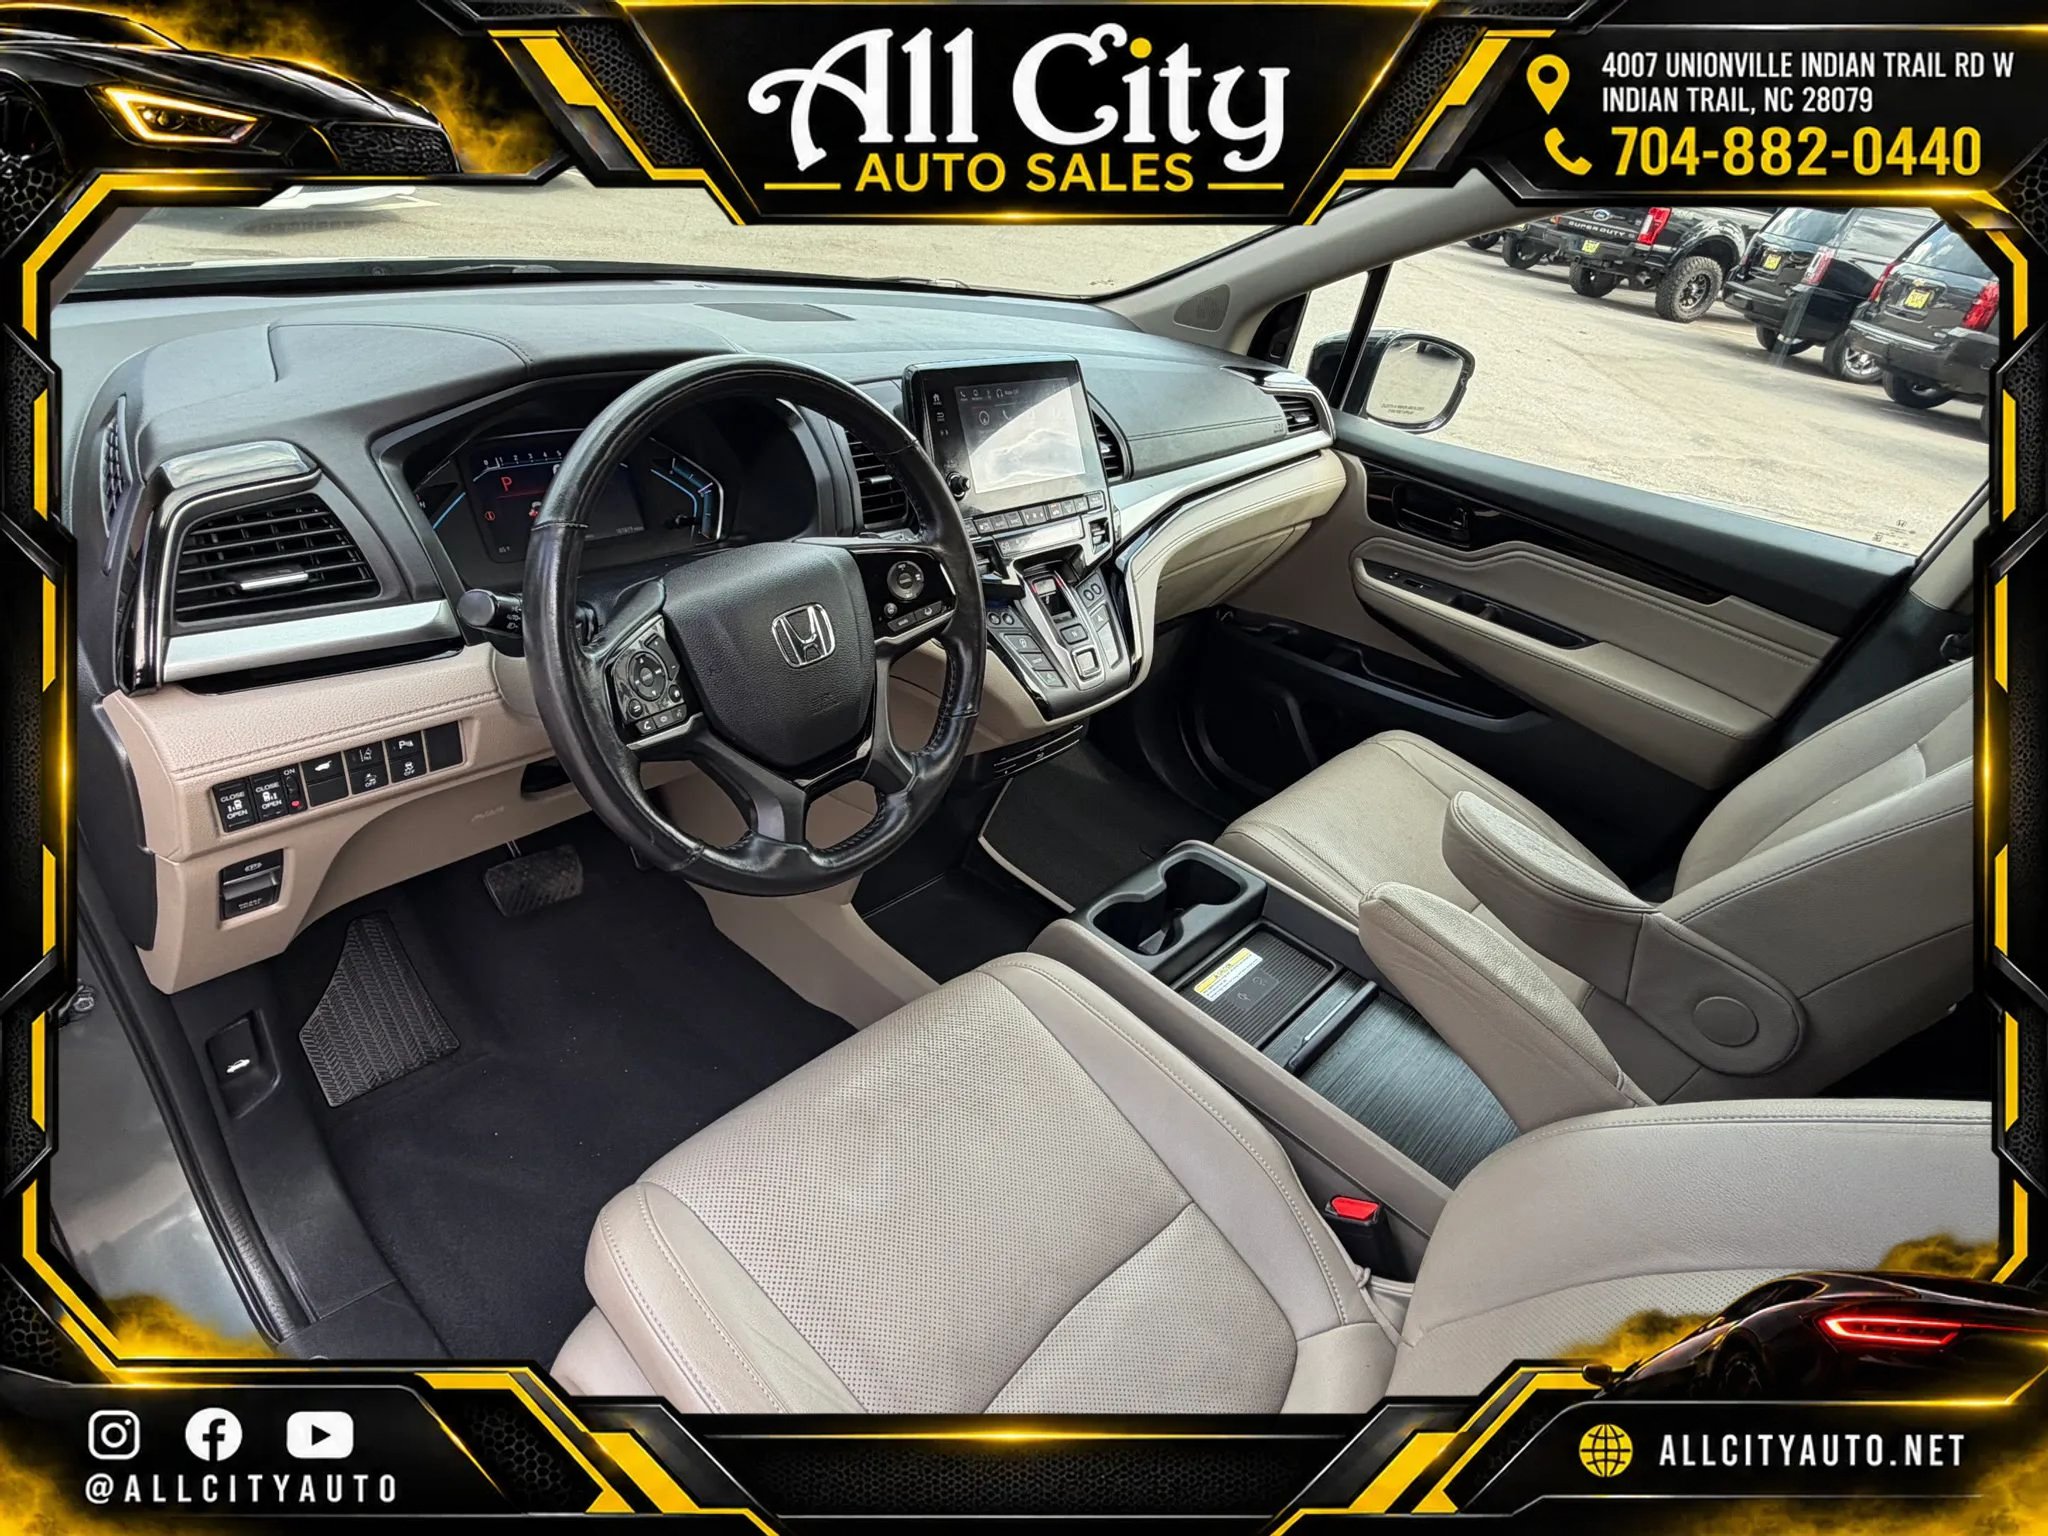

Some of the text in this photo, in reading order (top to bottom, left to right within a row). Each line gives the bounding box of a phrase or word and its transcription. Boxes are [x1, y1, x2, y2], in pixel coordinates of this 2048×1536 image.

[1568, 220, 1599, 232] SUPER
[1599, 227, 1626, 238] DUTY
[501, 476, 513, 492] P
[283, 768, 296, 776] ON
[255, 781, 280, 793] CLOSE
[220, 791, 245, 803] CLOSE
[261, 799, 282, 810] OPEN
[226, 808, 249, 820] OPEN
